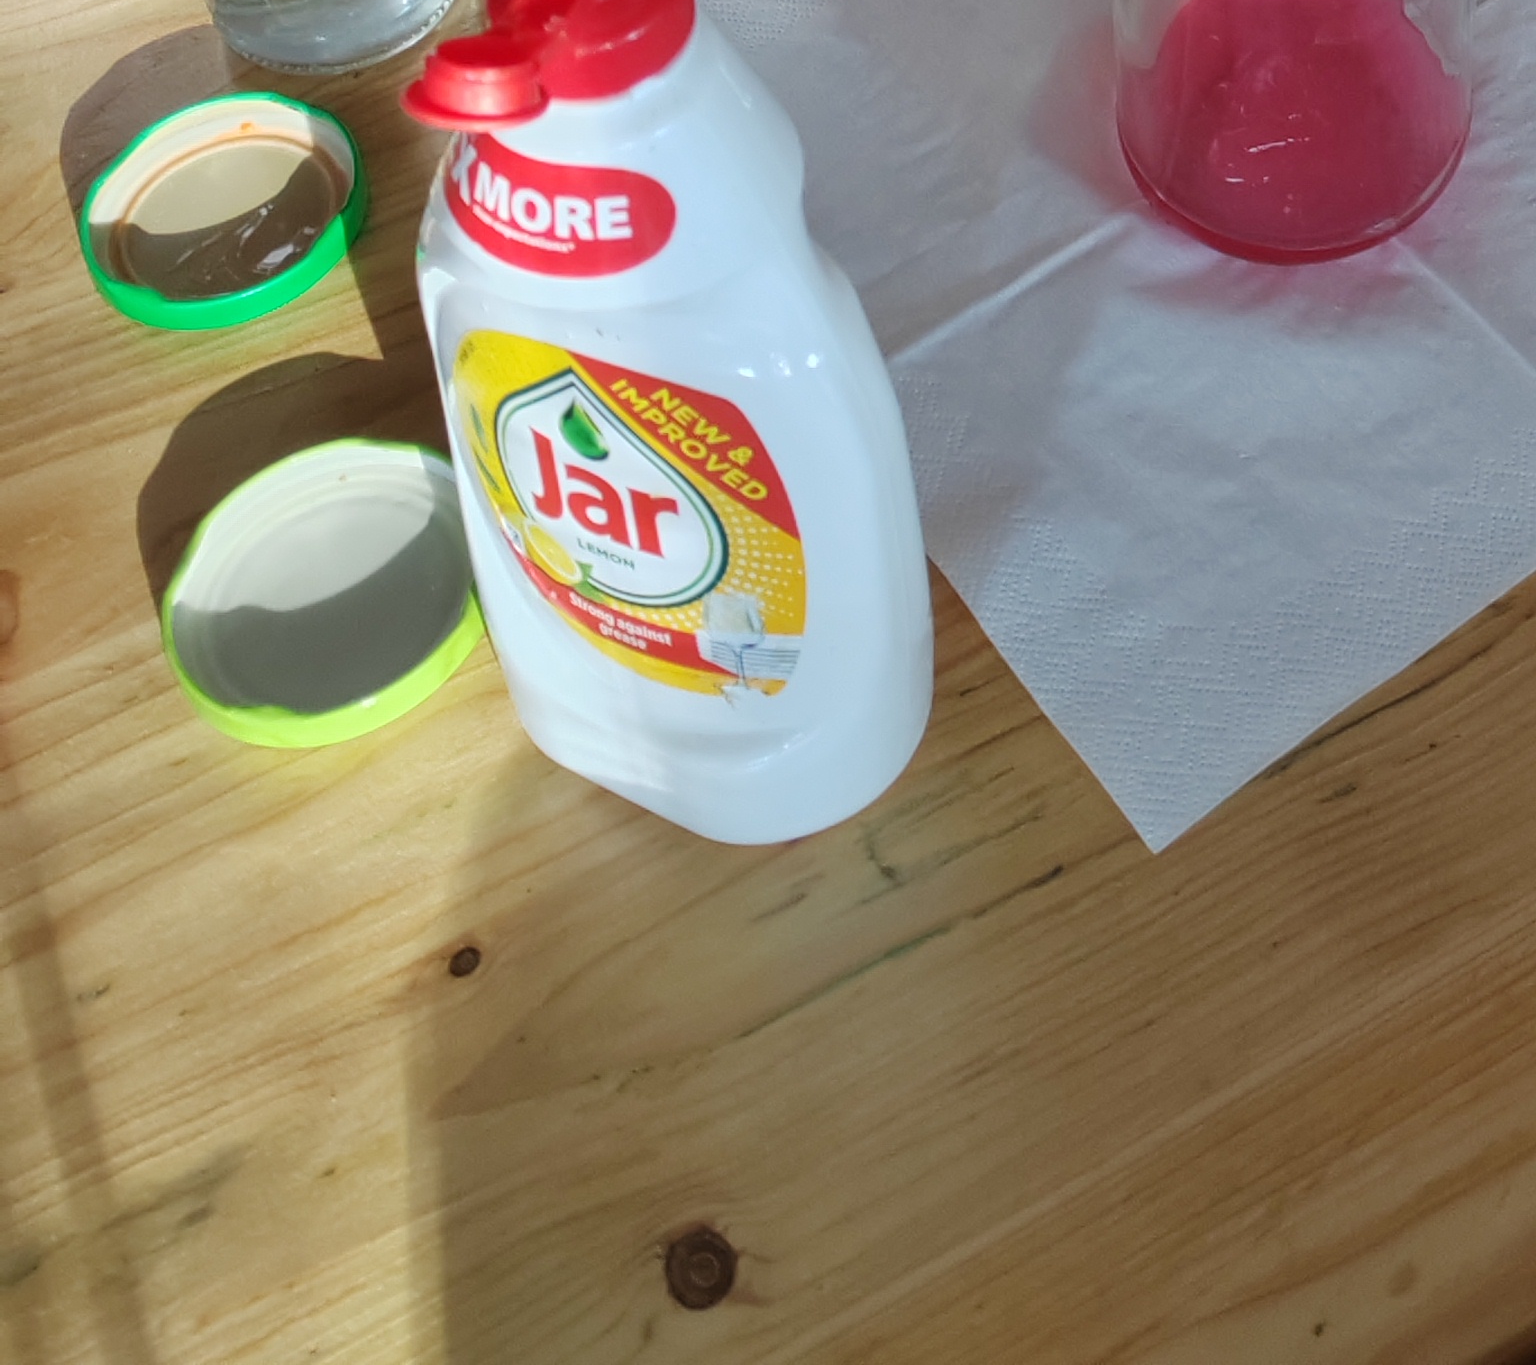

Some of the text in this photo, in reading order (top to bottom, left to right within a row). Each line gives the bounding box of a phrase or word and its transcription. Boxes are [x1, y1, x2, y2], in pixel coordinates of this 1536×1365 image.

[473, 161, 633, 241] MORE
[610, 378, 769, 501] IMPROVED
[650, 388, 754, 467] NEW &
[529, 426, 679, 558] Jar
[577, 537, 636, 571] LEMON
[569, 591, 673, 647] Strong against
[599, 623, 649, 651] grease
